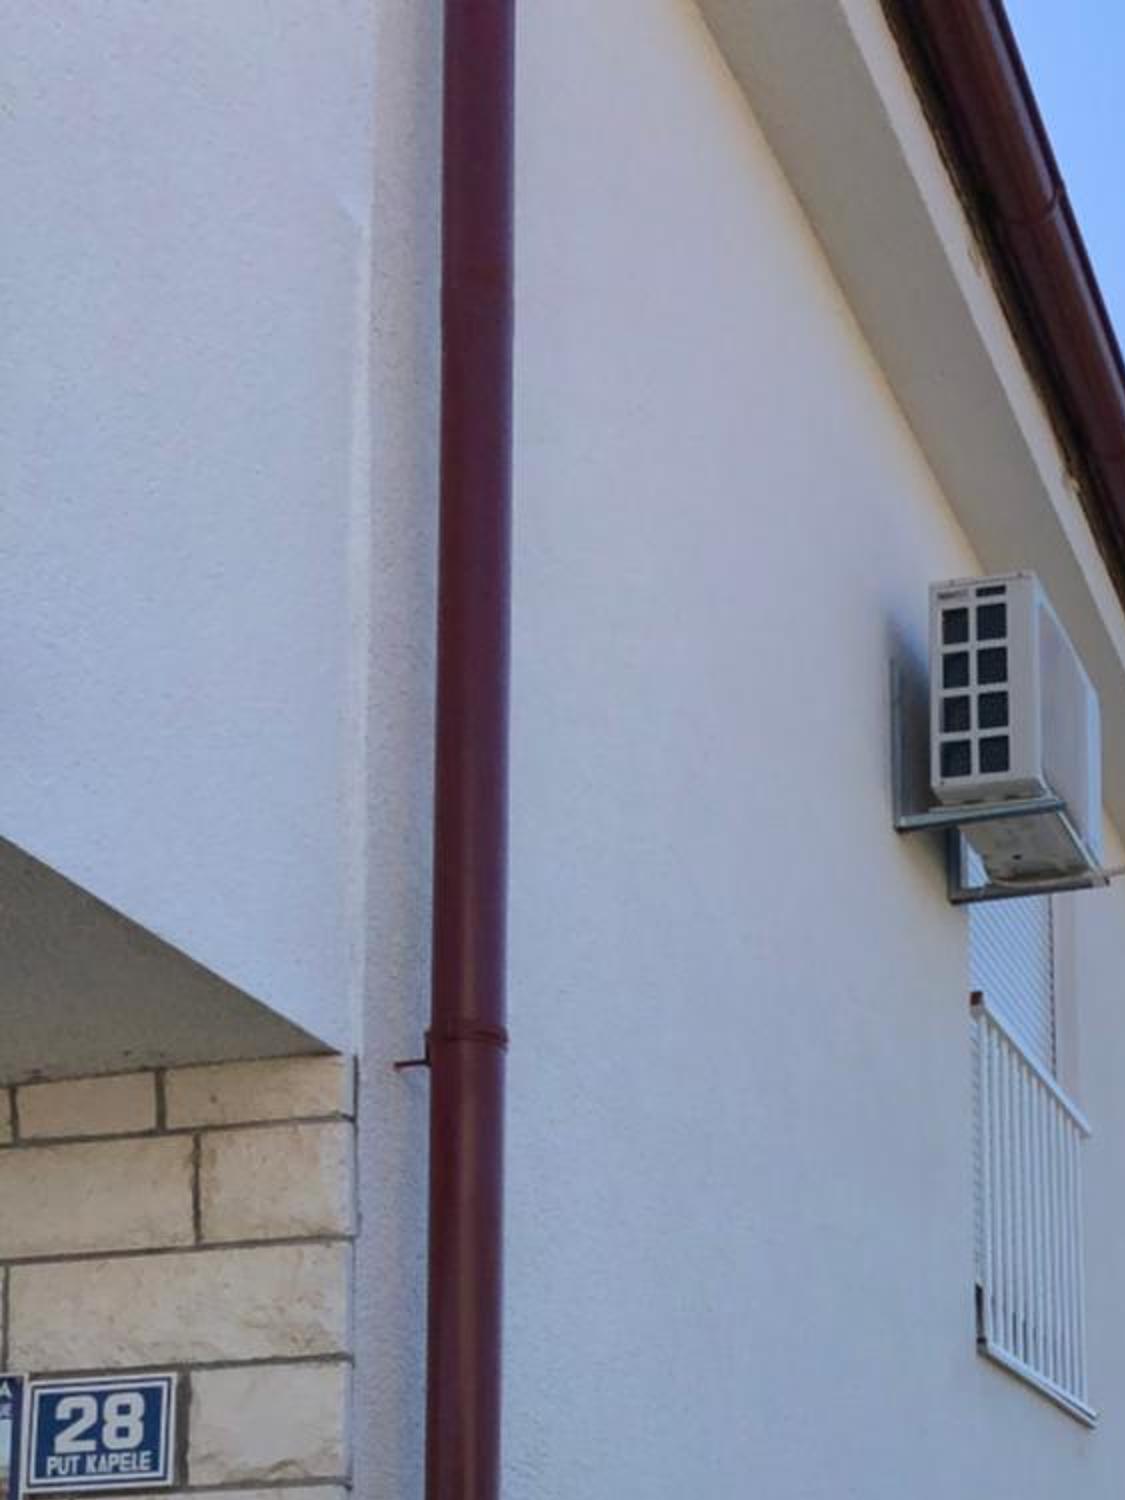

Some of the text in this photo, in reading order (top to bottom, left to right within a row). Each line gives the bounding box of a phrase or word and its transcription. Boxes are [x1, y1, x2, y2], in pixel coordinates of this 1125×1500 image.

[54, 1392, 145, 1454] 28
[47, 1451, 152, 1476] PUT KAPELE
